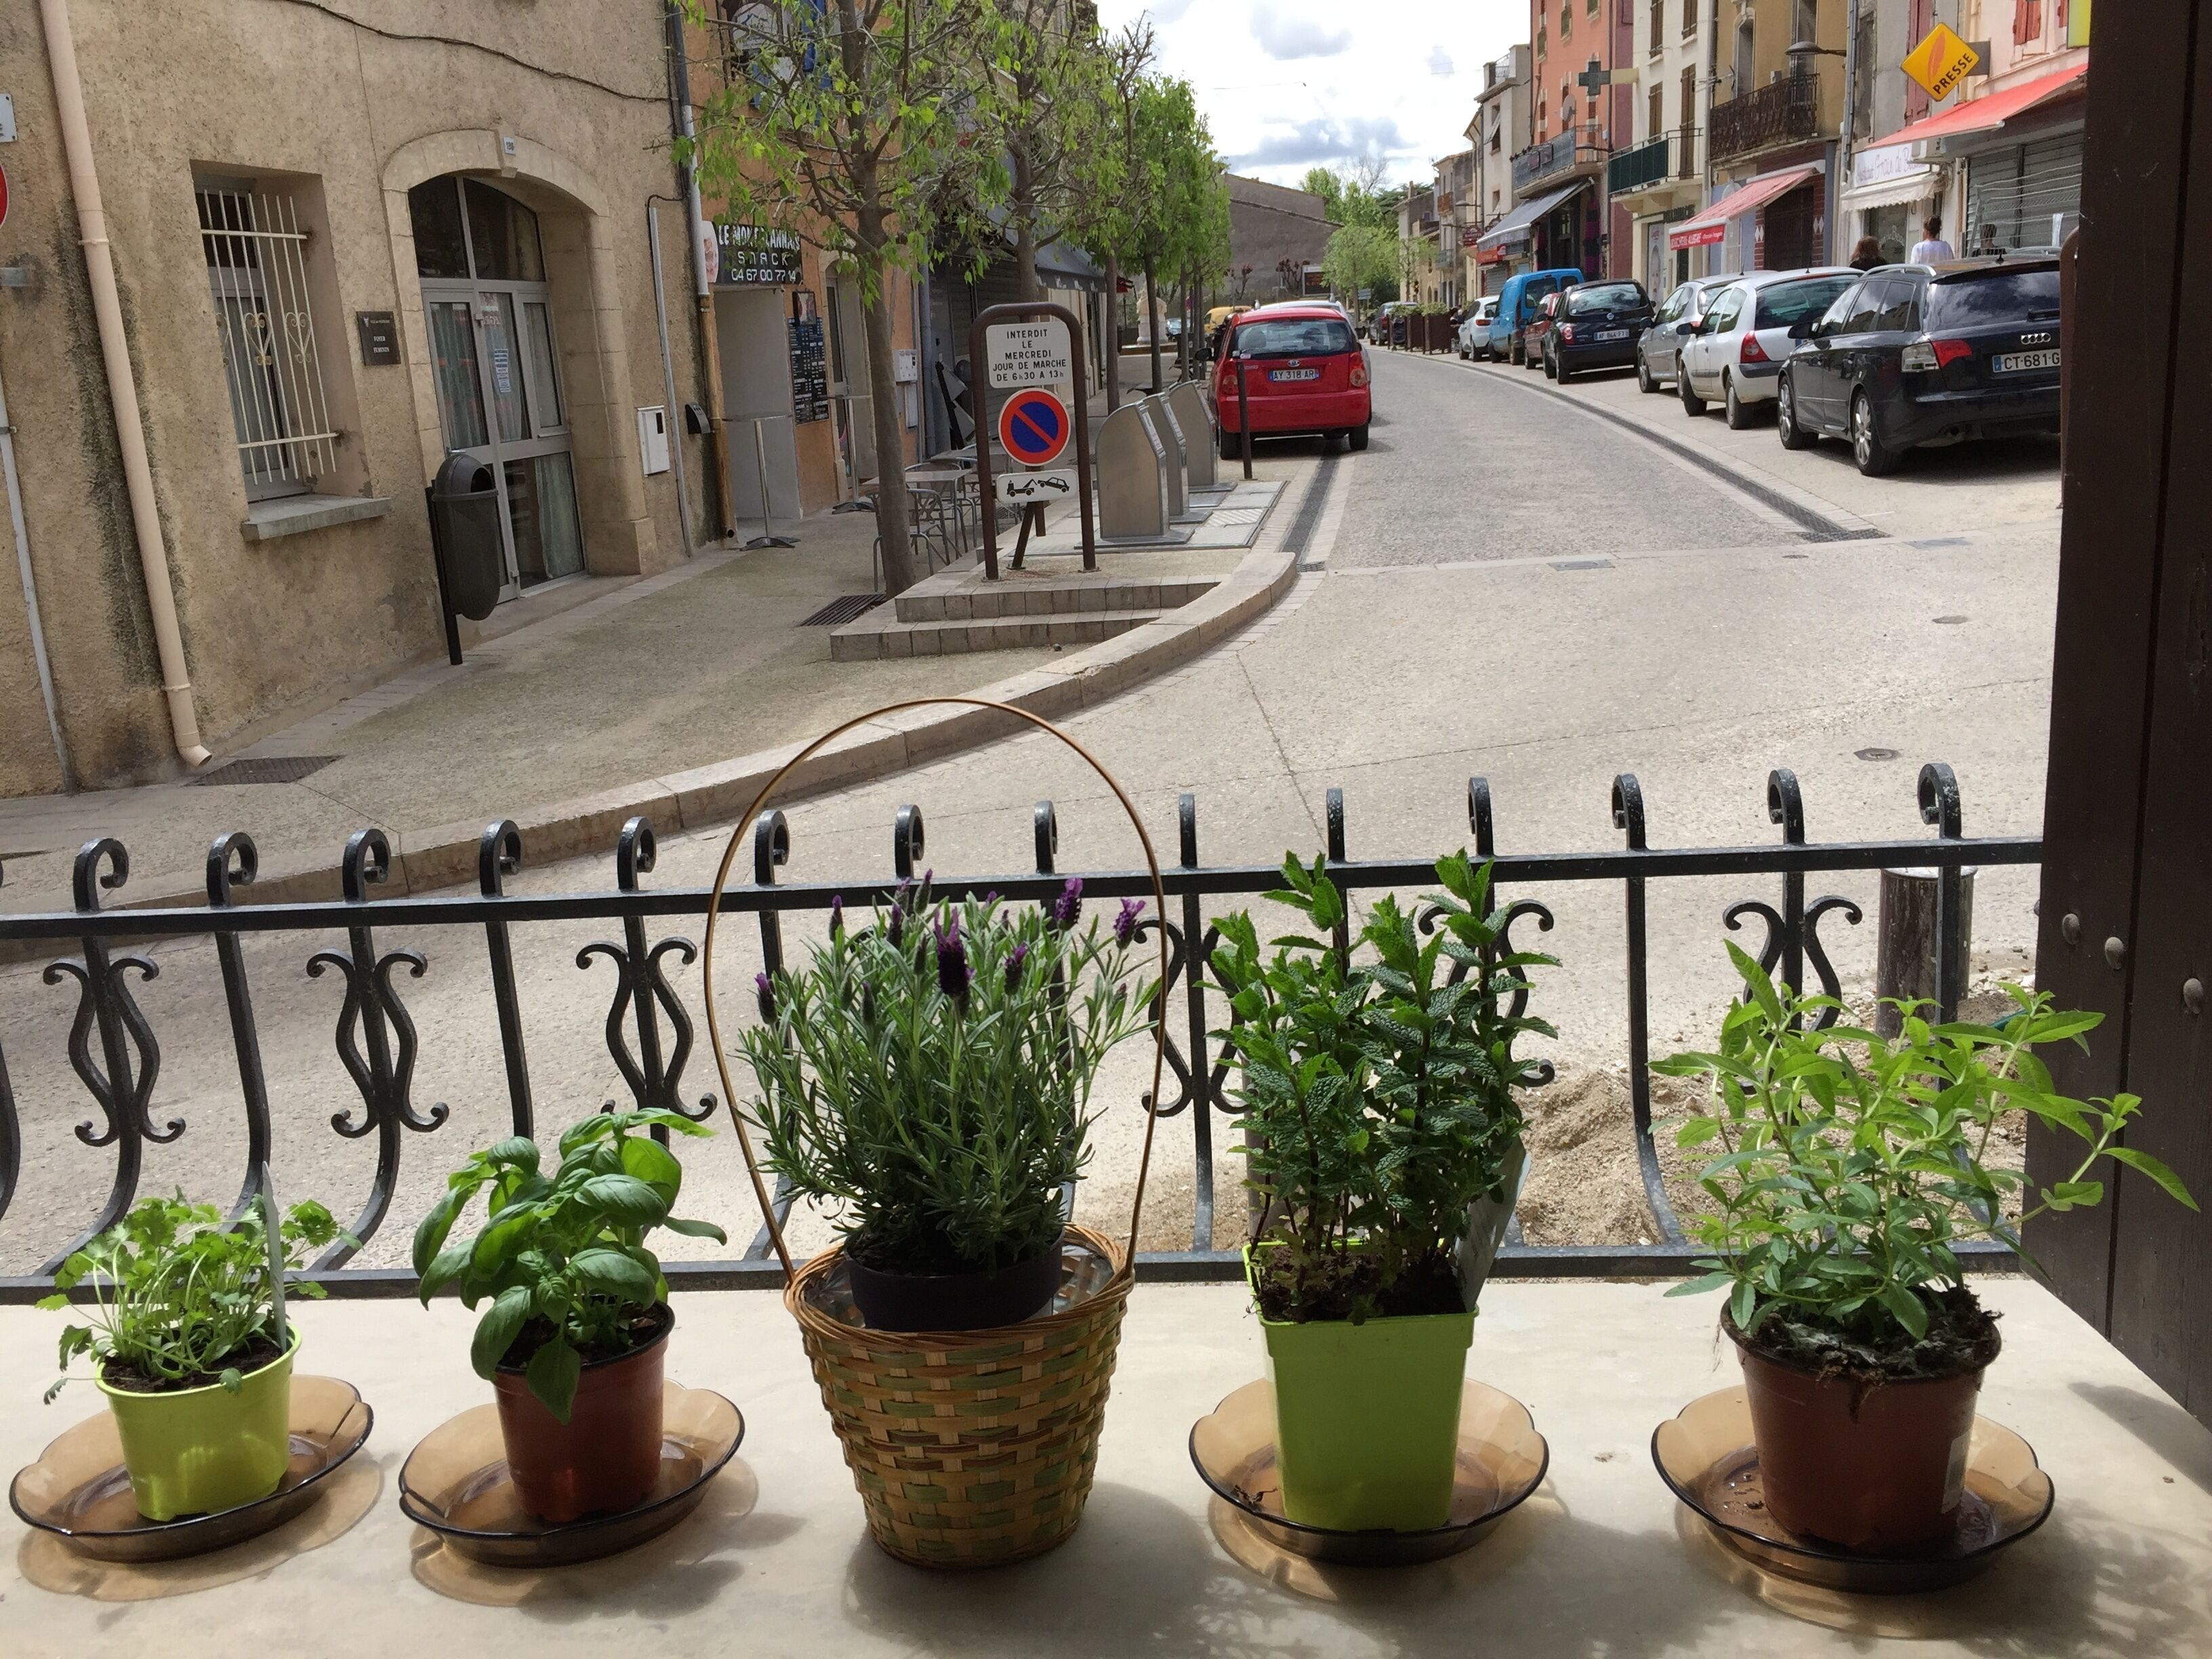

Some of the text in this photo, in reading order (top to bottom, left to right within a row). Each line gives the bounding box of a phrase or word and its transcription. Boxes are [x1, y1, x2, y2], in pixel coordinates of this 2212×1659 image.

[1932, 53, 1973, 94] PRESSE
[719, 224, 729, 245] LE
[746, 268, 757, 281] 67
[760, 270, 773, 281] 00
[775, 270, 786, 281] 77
[787, 270, 796, 281] 14
[1007, 329, 1047, 339] INTERDIT
[1022, 340, 1033, 348] LE
[1005, 350, 1051, 360] MERCREDI
[993, 359, 1067, 371] JOUR DE MARCHE
[997, 370, 1064, 382] DE 6h30 A 13h
